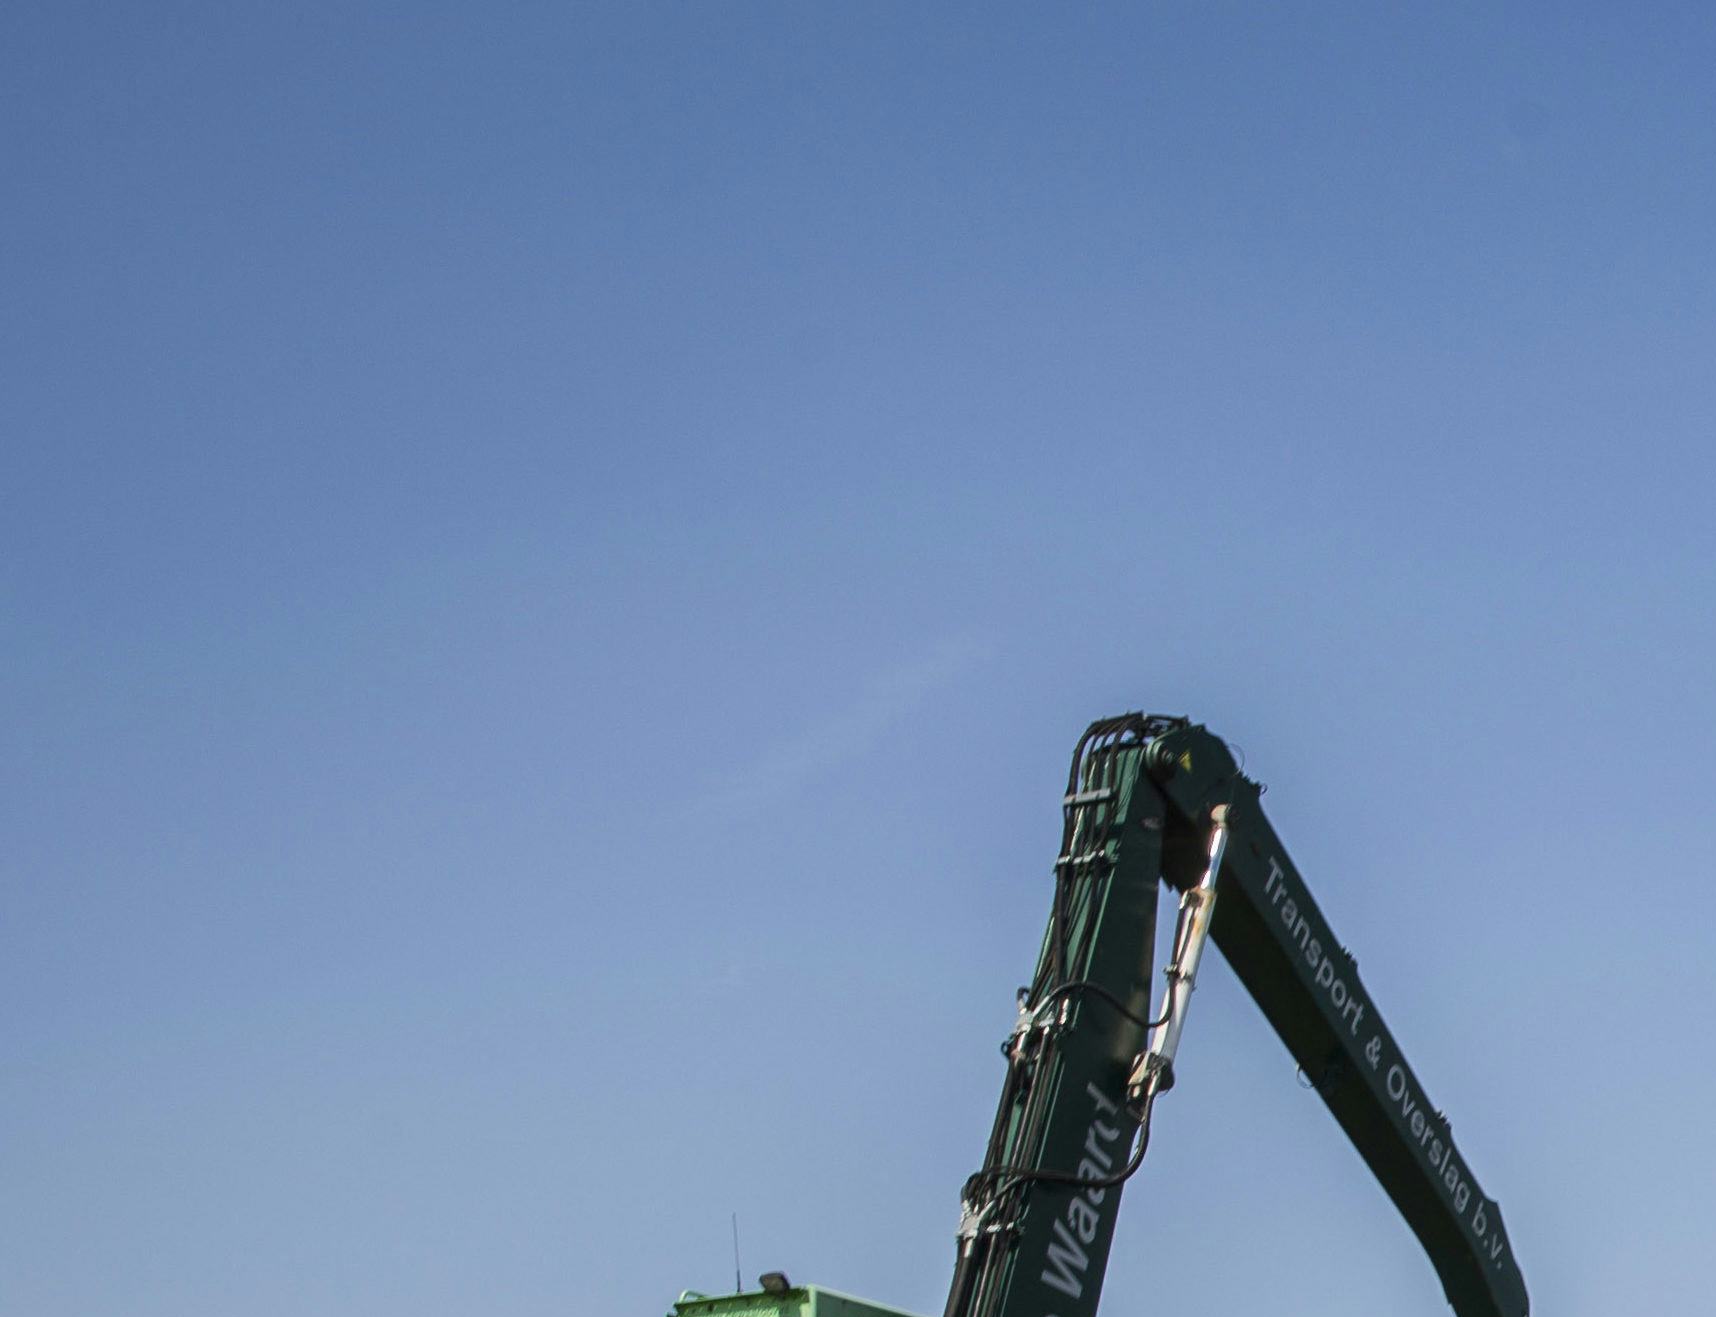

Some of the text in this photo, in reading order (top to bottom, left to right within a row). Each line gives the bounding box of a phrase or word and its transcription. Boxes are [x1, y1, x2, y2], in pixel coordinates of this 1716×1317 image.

[1262, 857, 1365, 1035] Transport
[1365, 1036, 1383, 1070] &
[1386, 1065, 1471, 1213] Overslag
